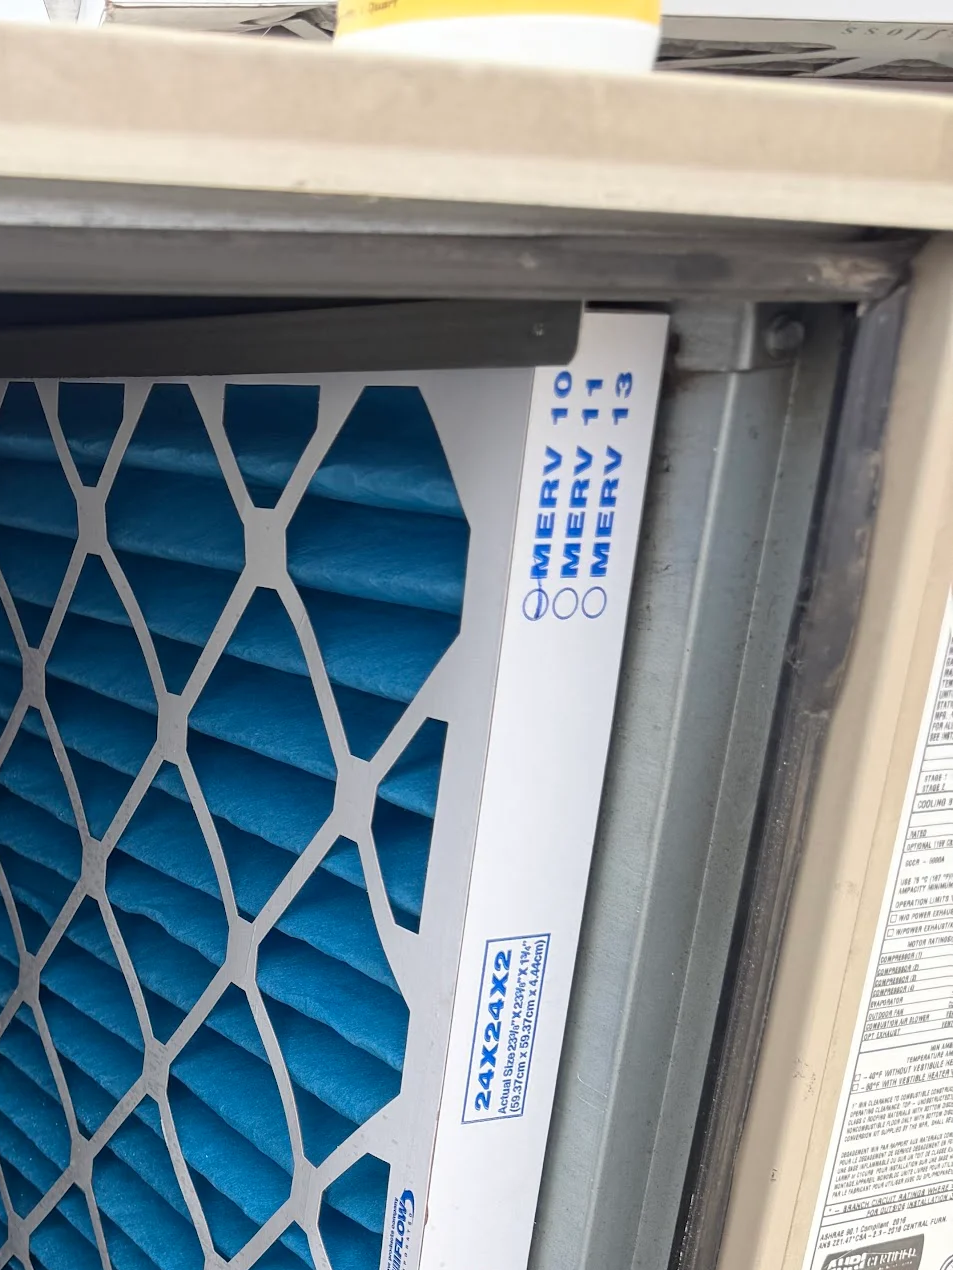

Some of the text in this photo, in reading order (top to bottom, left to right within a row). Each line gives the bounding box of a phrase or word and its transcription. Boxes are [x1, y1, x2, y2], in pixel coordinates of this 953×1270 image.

[530, 370, 572, 579] MERV 10
[560, 379, 603, 578] MERV 11
[590, 371, 633, 577] MERV 13
[925, 774, 942, 782] STAGE
[923, 784, 940, 793] STAGE
[918, 799, 946, 809] COOLING
[907, 841, 931, 850] OPTIONAL
[895, 896, 948, 908] OPERATION LIMITS
[474, 950, 512, 1111] 24X24X2
[509, 1066, 527, 1113] (59.37cm
[520, 1000, 536, 1050] 59.37cm
[530, 939, 546, 987] 4.44cm)
[503, 1055, 515, 1076] Size
[906, 1051, 943, 1063] TEMPERATURE
[882, 1079, 897, 1087] WITH
[927, 1069, 949, 1080] HEATER
[884, 1066, 911, 1077] WITHOUT
[498, 1079, 511, 1114] Actual
[843, 1200, 869, 1213] BRANCH
[870, 1196, 897, 1207] CIRCUIT
[906, 1193, 949, 1209] INSTALLATION
[820, 1230, 844, 1241] ASHRAE
[860, 1221, 890, 1235] Compliant
[903, 1220, 929, 1232] CENTRAL
